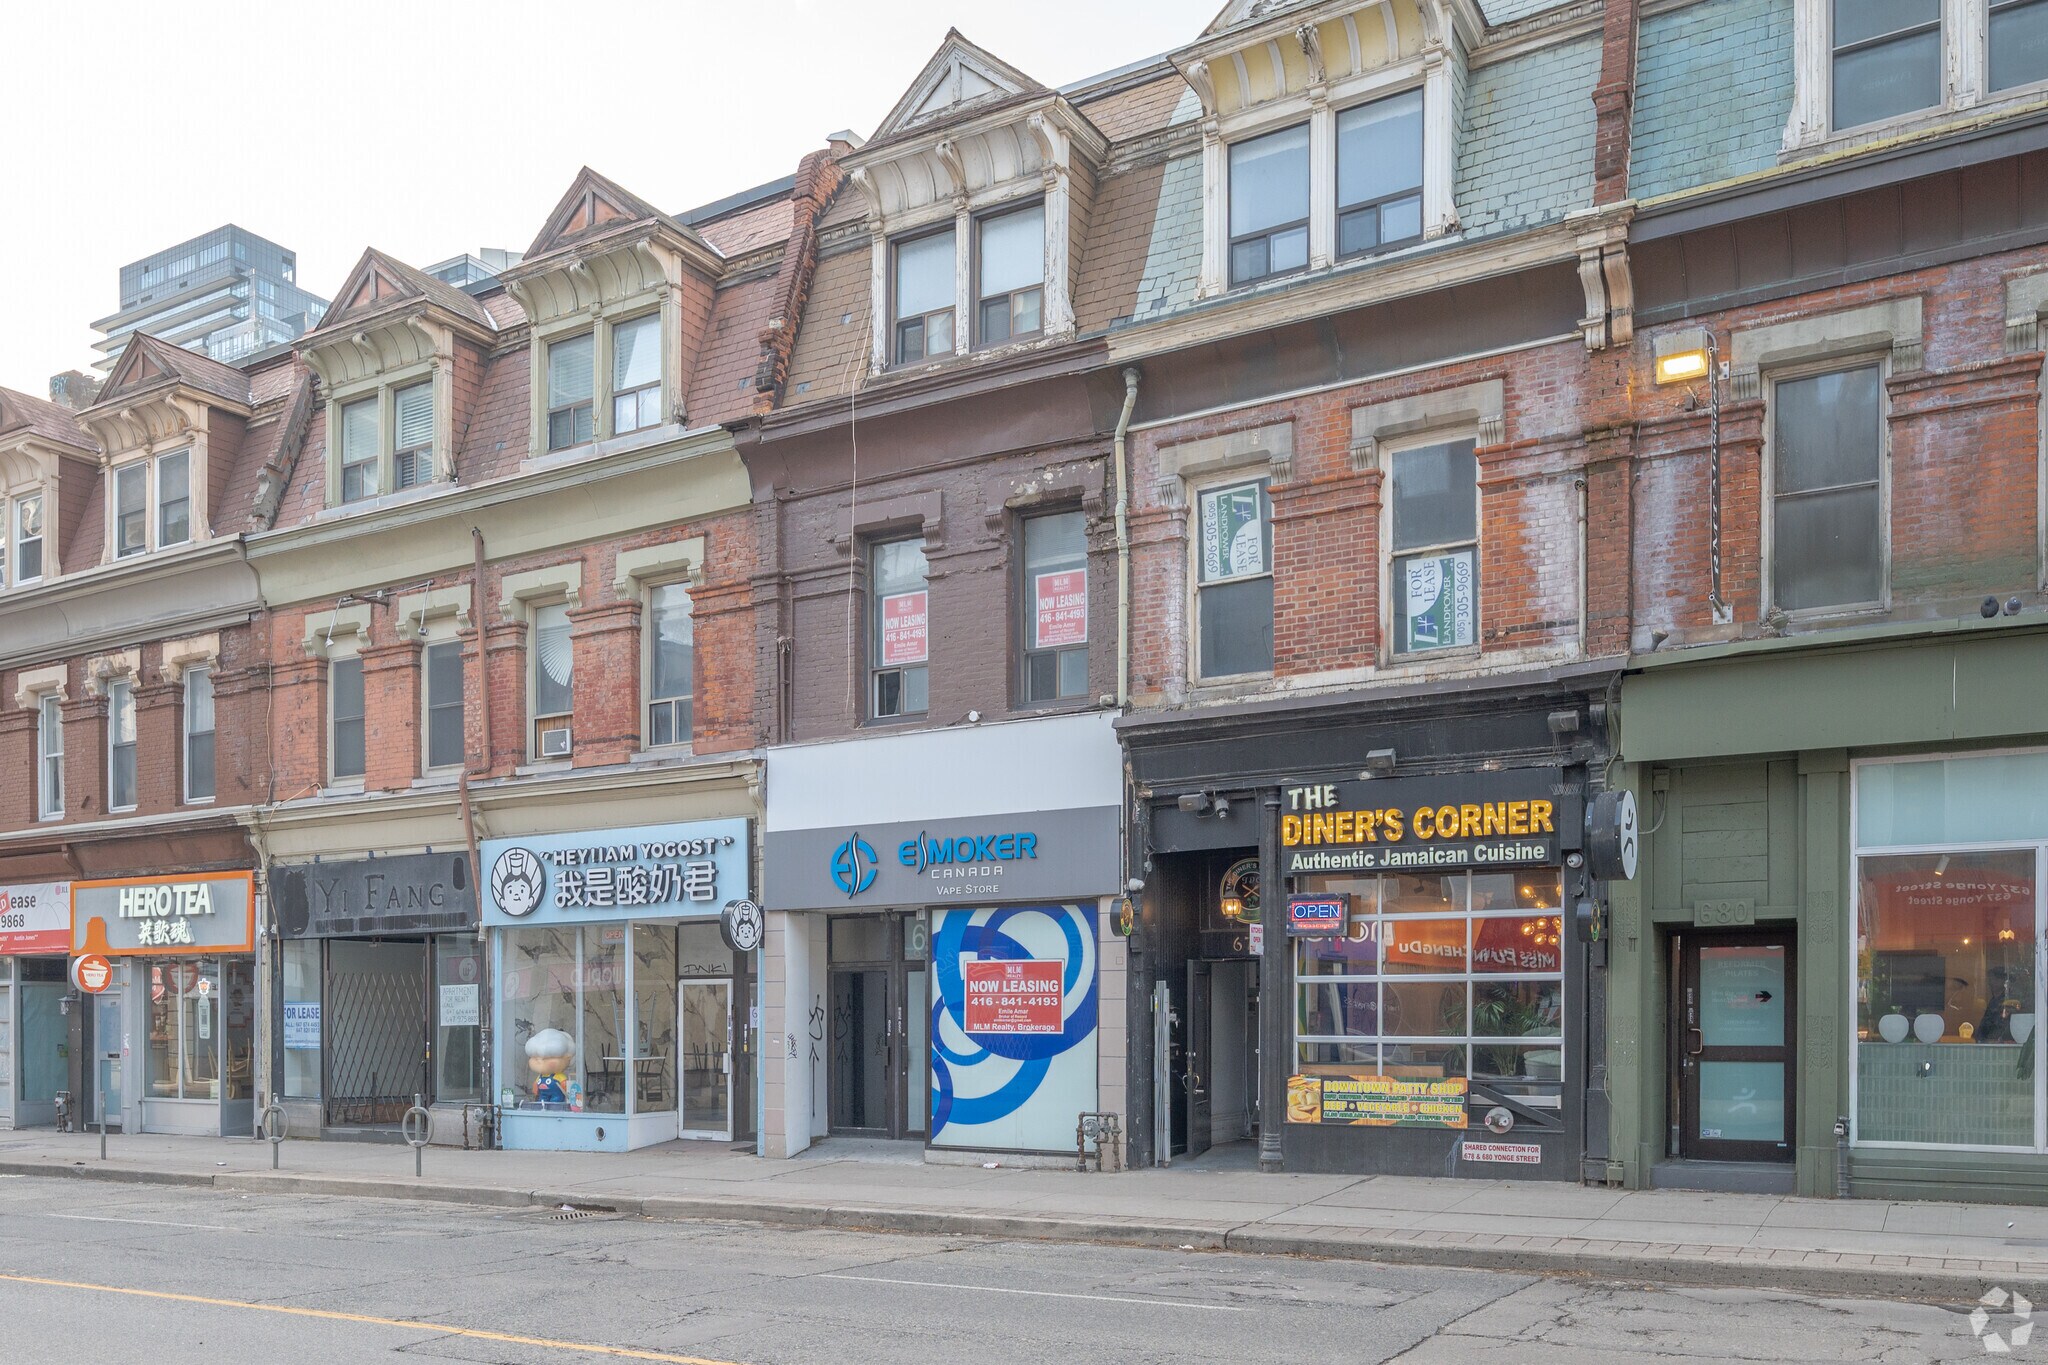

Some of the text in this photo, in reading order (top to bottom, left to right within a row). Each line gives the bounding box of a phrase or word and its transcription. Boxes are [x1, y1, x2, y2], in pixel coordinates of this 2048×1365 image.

[1206, 501, 1218, 573] (905) 305-9669
[1220, 495, 1229, 560] LANDPOWER
[1236, 534, 1247, 573] LEASE
[1247, 537, 1259, 565] FOR
[1411, 568, 1422, 598] FOR
[1424, 560, 1436, 602] LEASE
[1040, 592, 1084, 610] NOW LEASING
[1443, 575, 1451, 644] LANDPOWER
[1456, 561, 1469, 640] (905) 305-9669
[886, 613, 925, 630] NOW LEASING
[1288, 783, 1339, 810] THE
[1282, 799, 1554, 846] DINER'S CORNER
[1291, 842, 1545, 870] Authentic Jamaican Cuisine
[931, 865, 1003, 879] CANADA
[554, 860, 719, 909] 我是酸奶君
[1, 914, 25, 928] 9868
[1294, 904, 1340, 918] OPEN
[1700, 902, 1747, 924] 680
[605, 930, 624, 939] OPEN
[1007, 966, 1021, 974] MLM
[970, 980, 1059, 993] NOW LEASING
[971, 997, 993, 1006] 416
[298, 1008, 320, 1019] LEASE
[992, 1023, 1015, 1031] Realty,
[1017, 1024, 1055, 1032] Brokerage
[1324, 1081, 1463, 1095] DOWNTOWN PATTY SHOP
[1323, 1101, 1462, 1114] BEEF VEGETABLE CHICKEN
